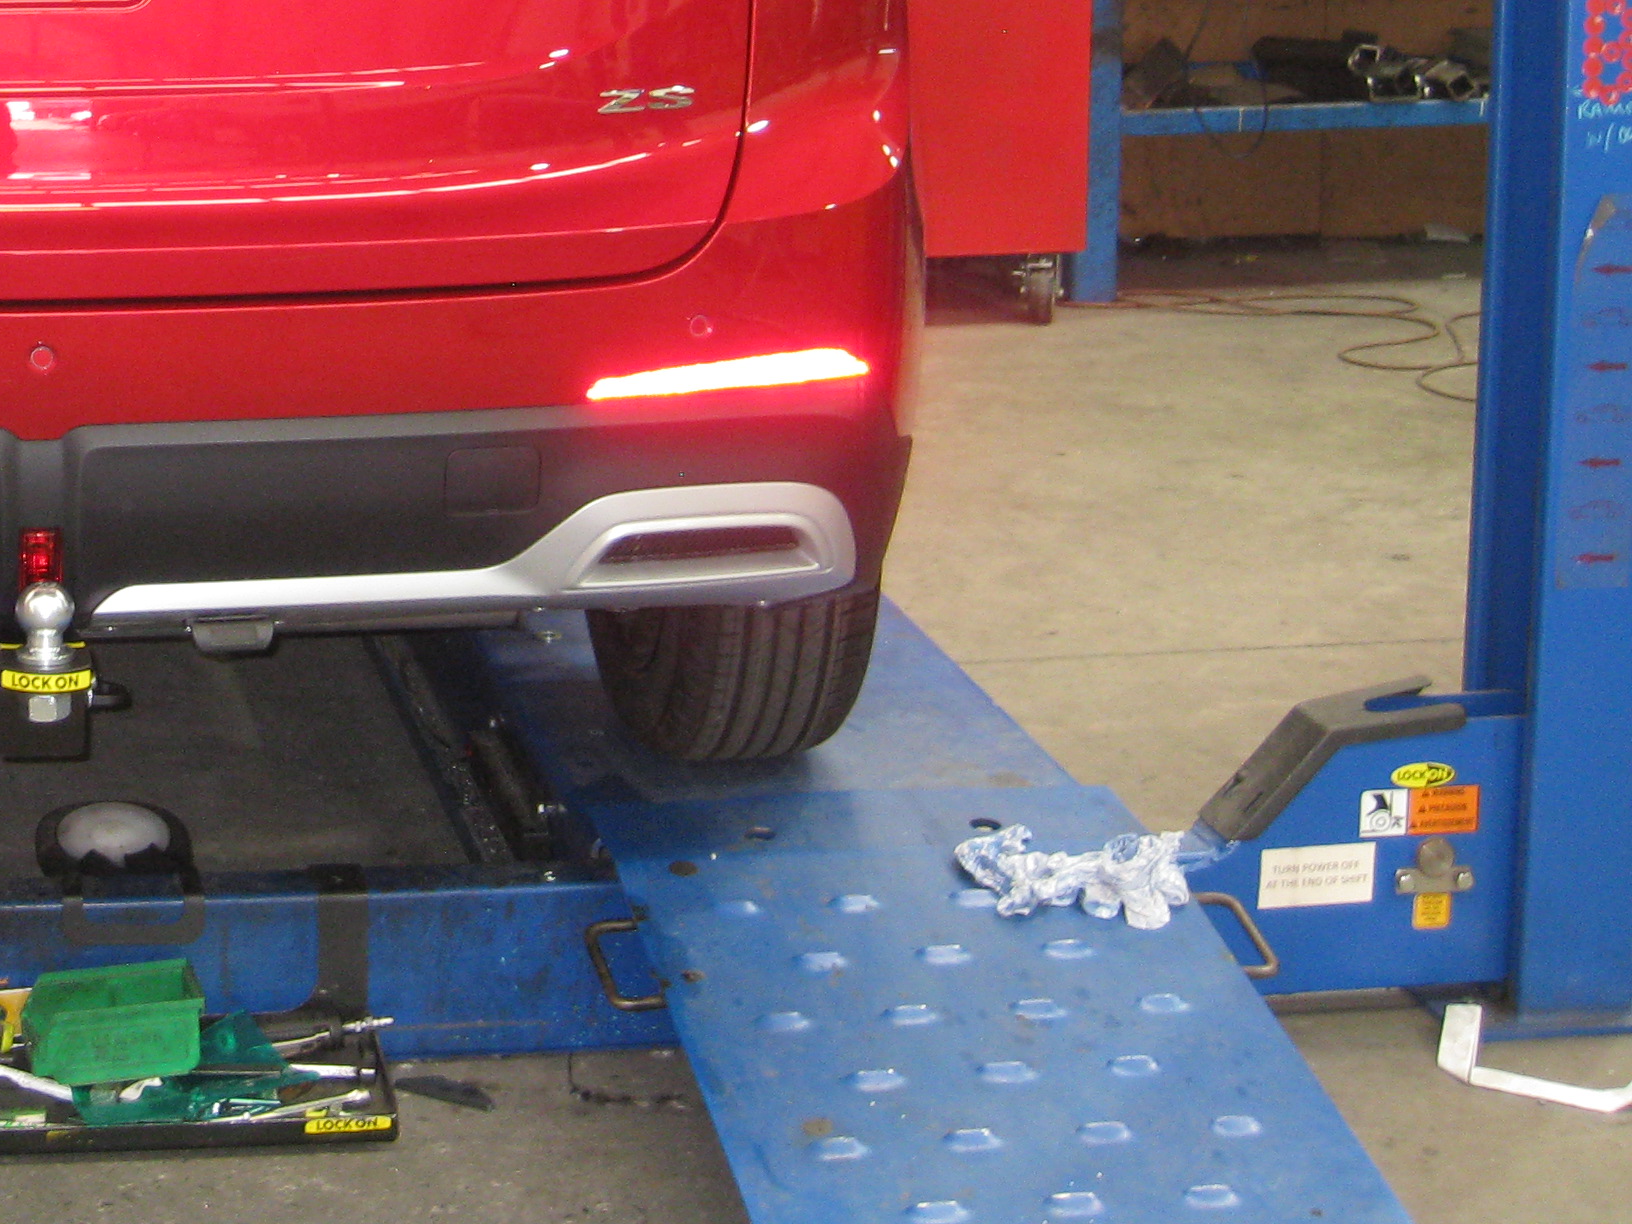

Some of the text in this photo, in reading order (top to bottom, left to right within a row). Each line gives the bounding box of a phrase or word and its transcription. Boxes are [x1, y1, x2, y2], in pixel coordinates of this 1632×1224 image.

[597, 84, 695, 114] ZS
[11, 673, 79, 690] LOCK ON
[1396, 766, 1449, 781] LOCK ON
[1273, 859, 1360, 874] TURN POWER OFF
[1281, 878, 1299, 888] THE
[1301, 876, 1323, 887] END
[1325, 875, 1339, 885] OF
[1341, 873, 1368, 884] SHIFT
[316, 1116, 378, 1131] LOCK ON
